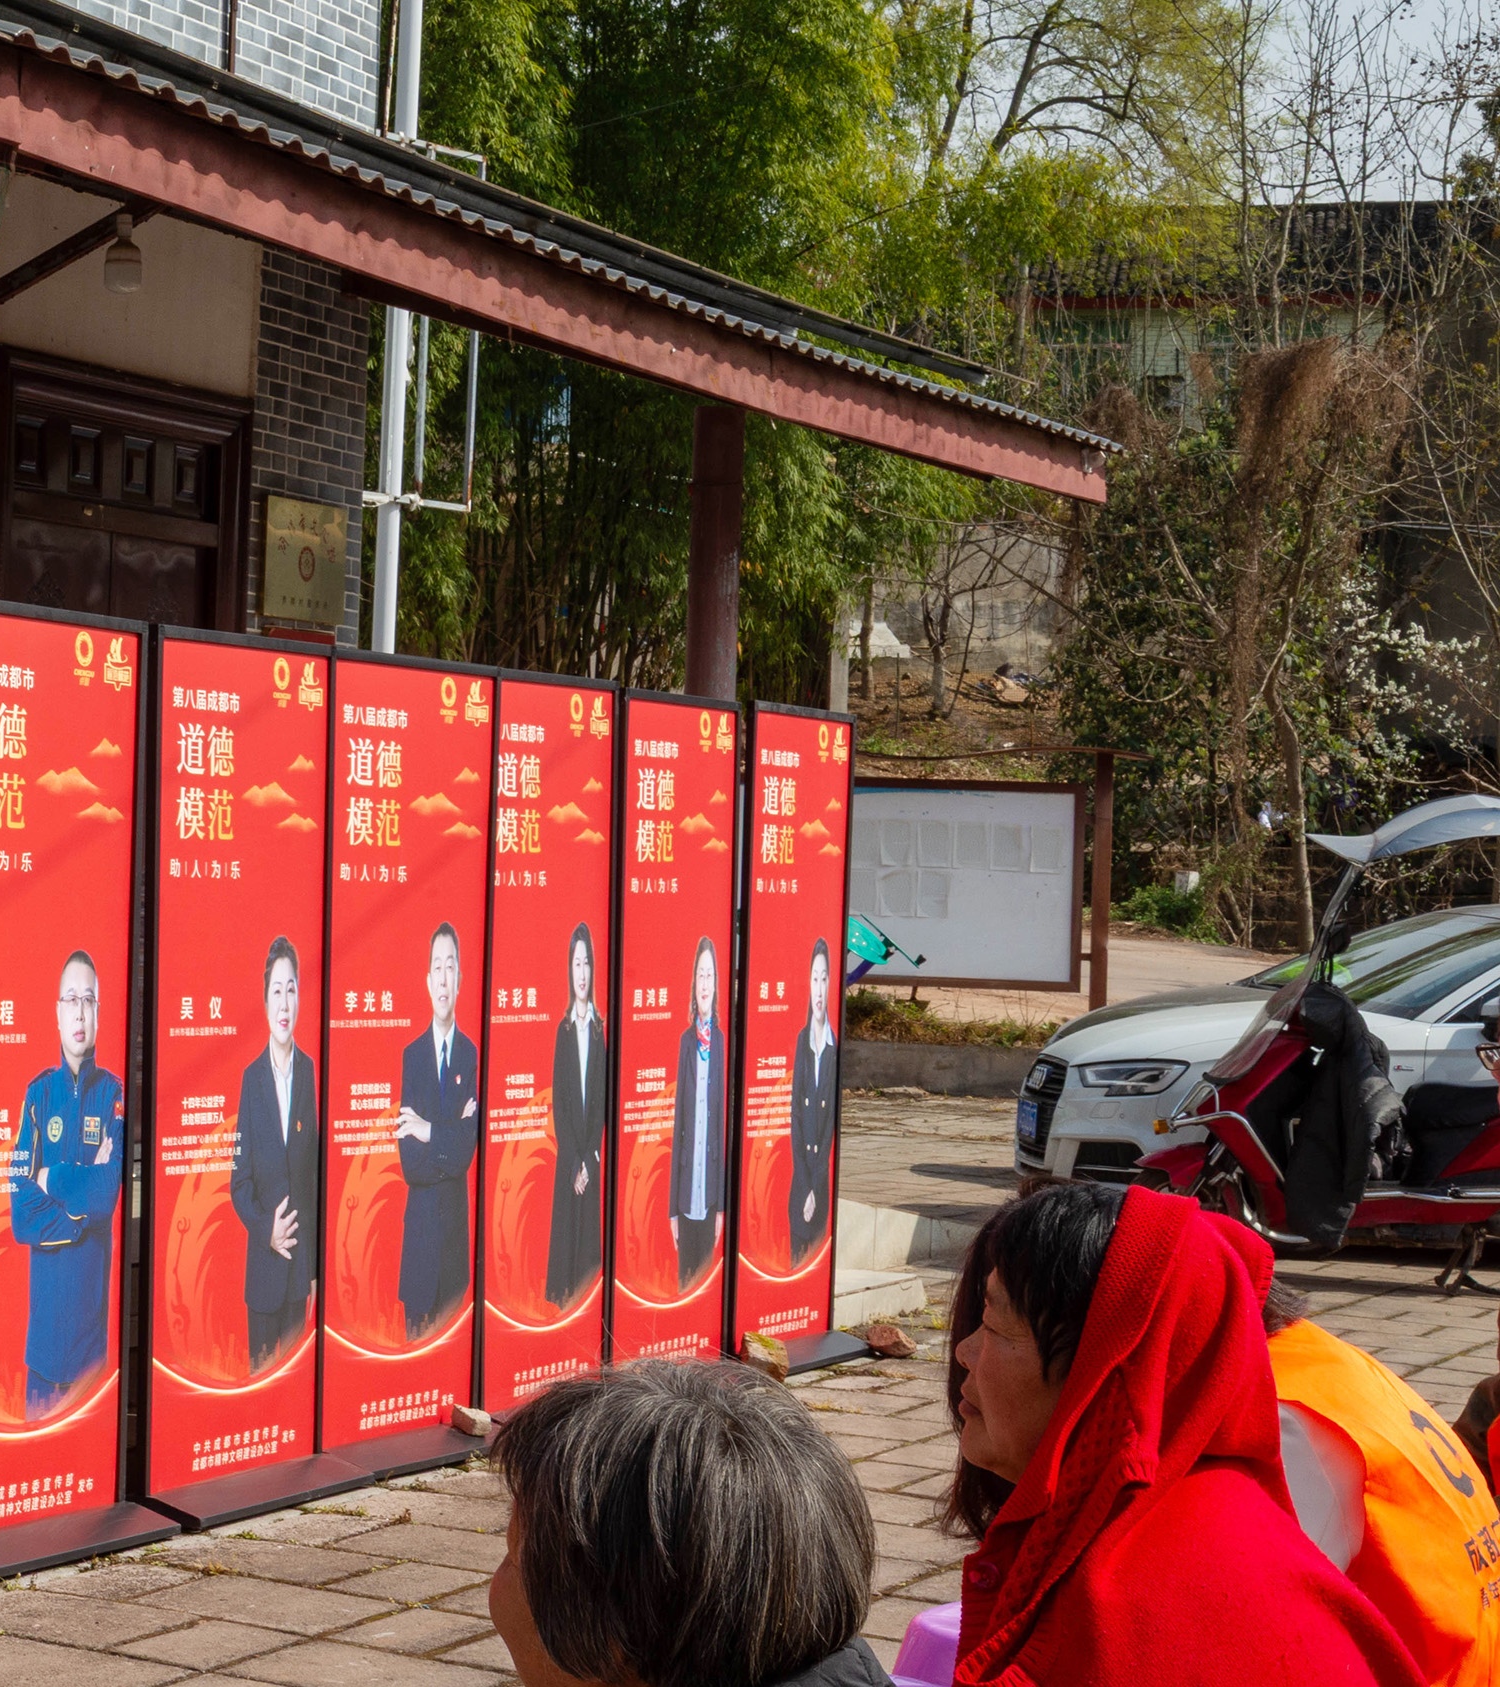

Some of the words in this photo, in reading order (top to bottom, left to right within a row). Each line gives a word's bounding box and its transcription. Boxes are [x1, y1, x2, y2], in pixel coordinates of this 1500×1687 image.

[172, 686, 240, 714] 第八届成都市
[343, 704, 408, 729] 第八届成都市
[176, 723, 234, 777] 道德
[501, 723, 545, 743] 八届成都市
[635, 739, 679, 759] 第八届成都市
[347, 737, 403, 788] 道德
[497, 753, 541, 798] 道德
[637, 768, 675, 811] 道德
[762, 776, 797, 816] 道德
[175, 786, 234, 840] 模范
[346, 796, 401, 847] 模范
[496, 807, 541, 854] 模范
[636, 819, 674, 863] 模范
[760, 824, 795, 864] 模范
[193, 1425, 279, 1455] 中共成都市委宣传部
[282, 1429, 295, 1443] 发布
[78, 1477, 94, 1493] 发布
[1464, 1521, 1500, 1575] 成都
